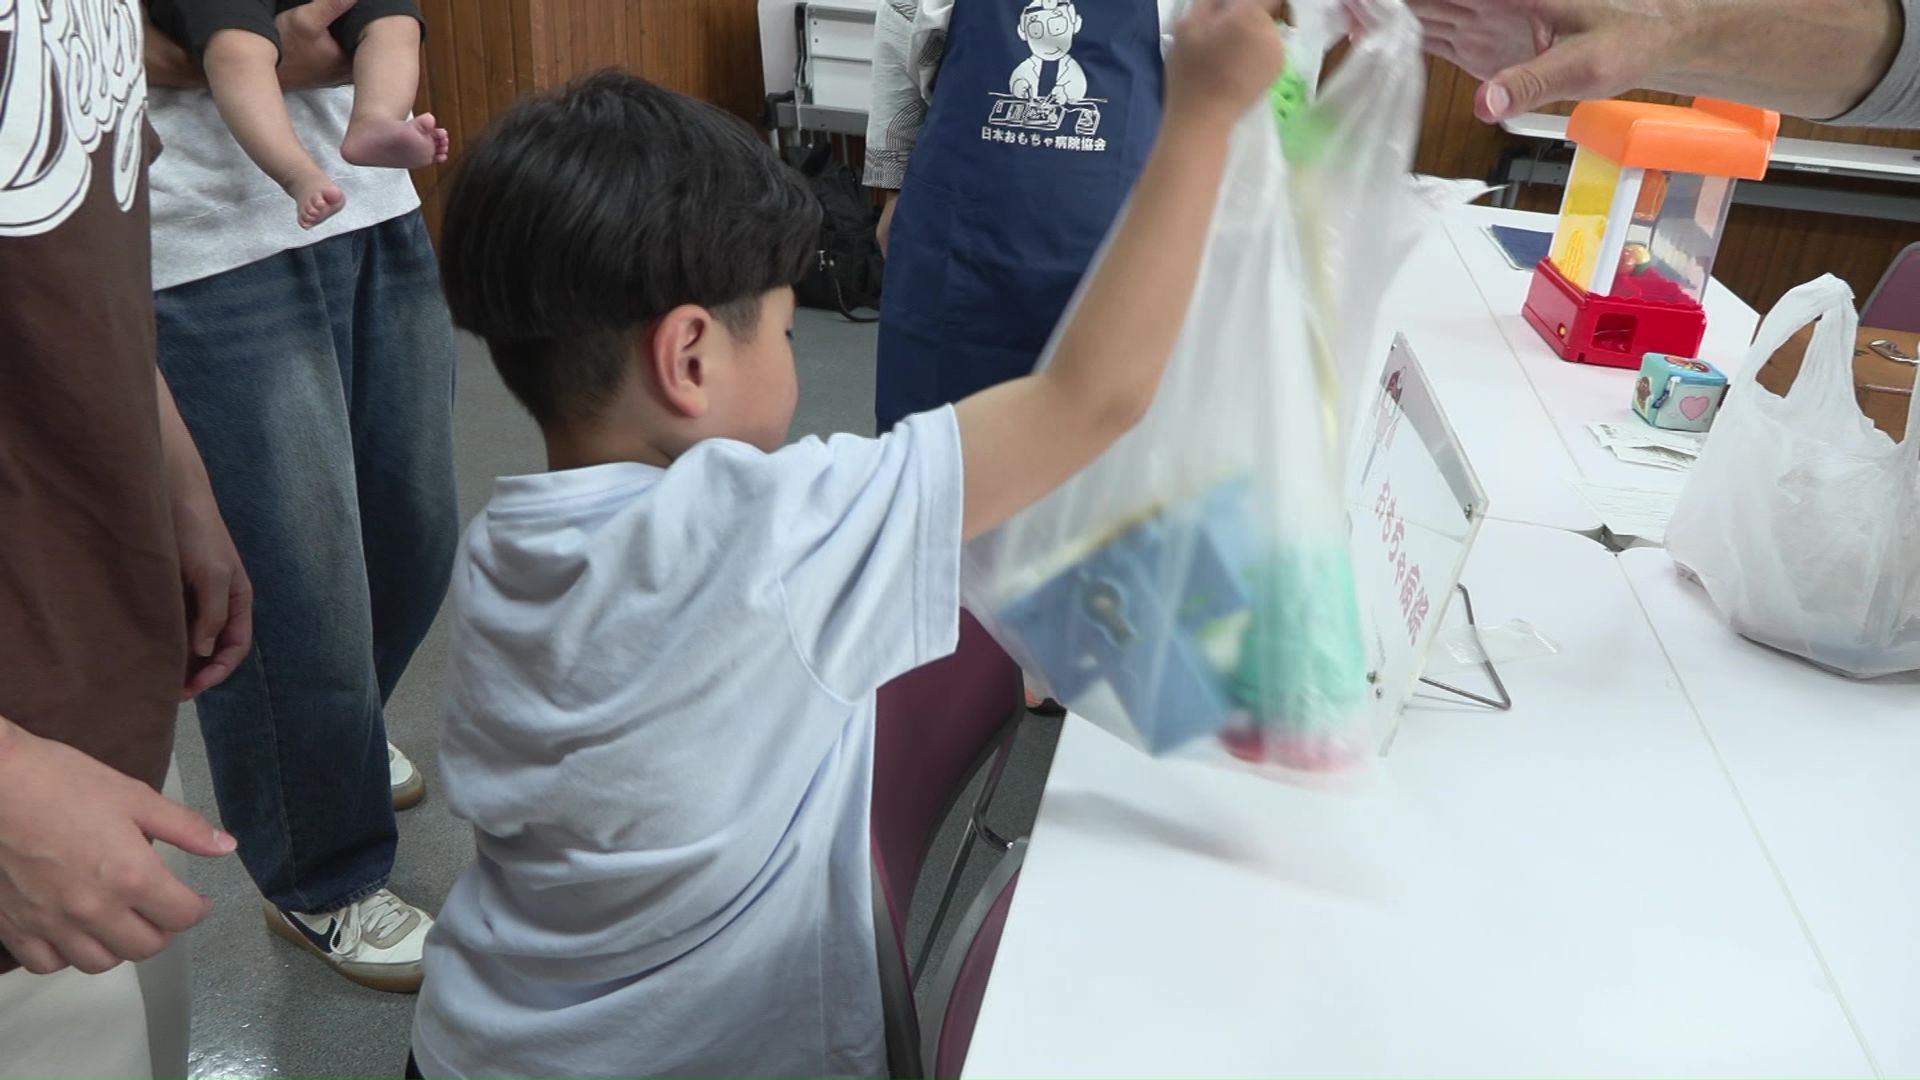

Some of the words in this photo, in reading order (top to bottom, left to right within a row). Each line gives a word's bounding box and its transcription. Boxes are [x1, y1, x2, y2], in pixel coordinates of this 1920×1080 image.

[981, 126, 1106, 151] 日本おもちゃ病院協会
